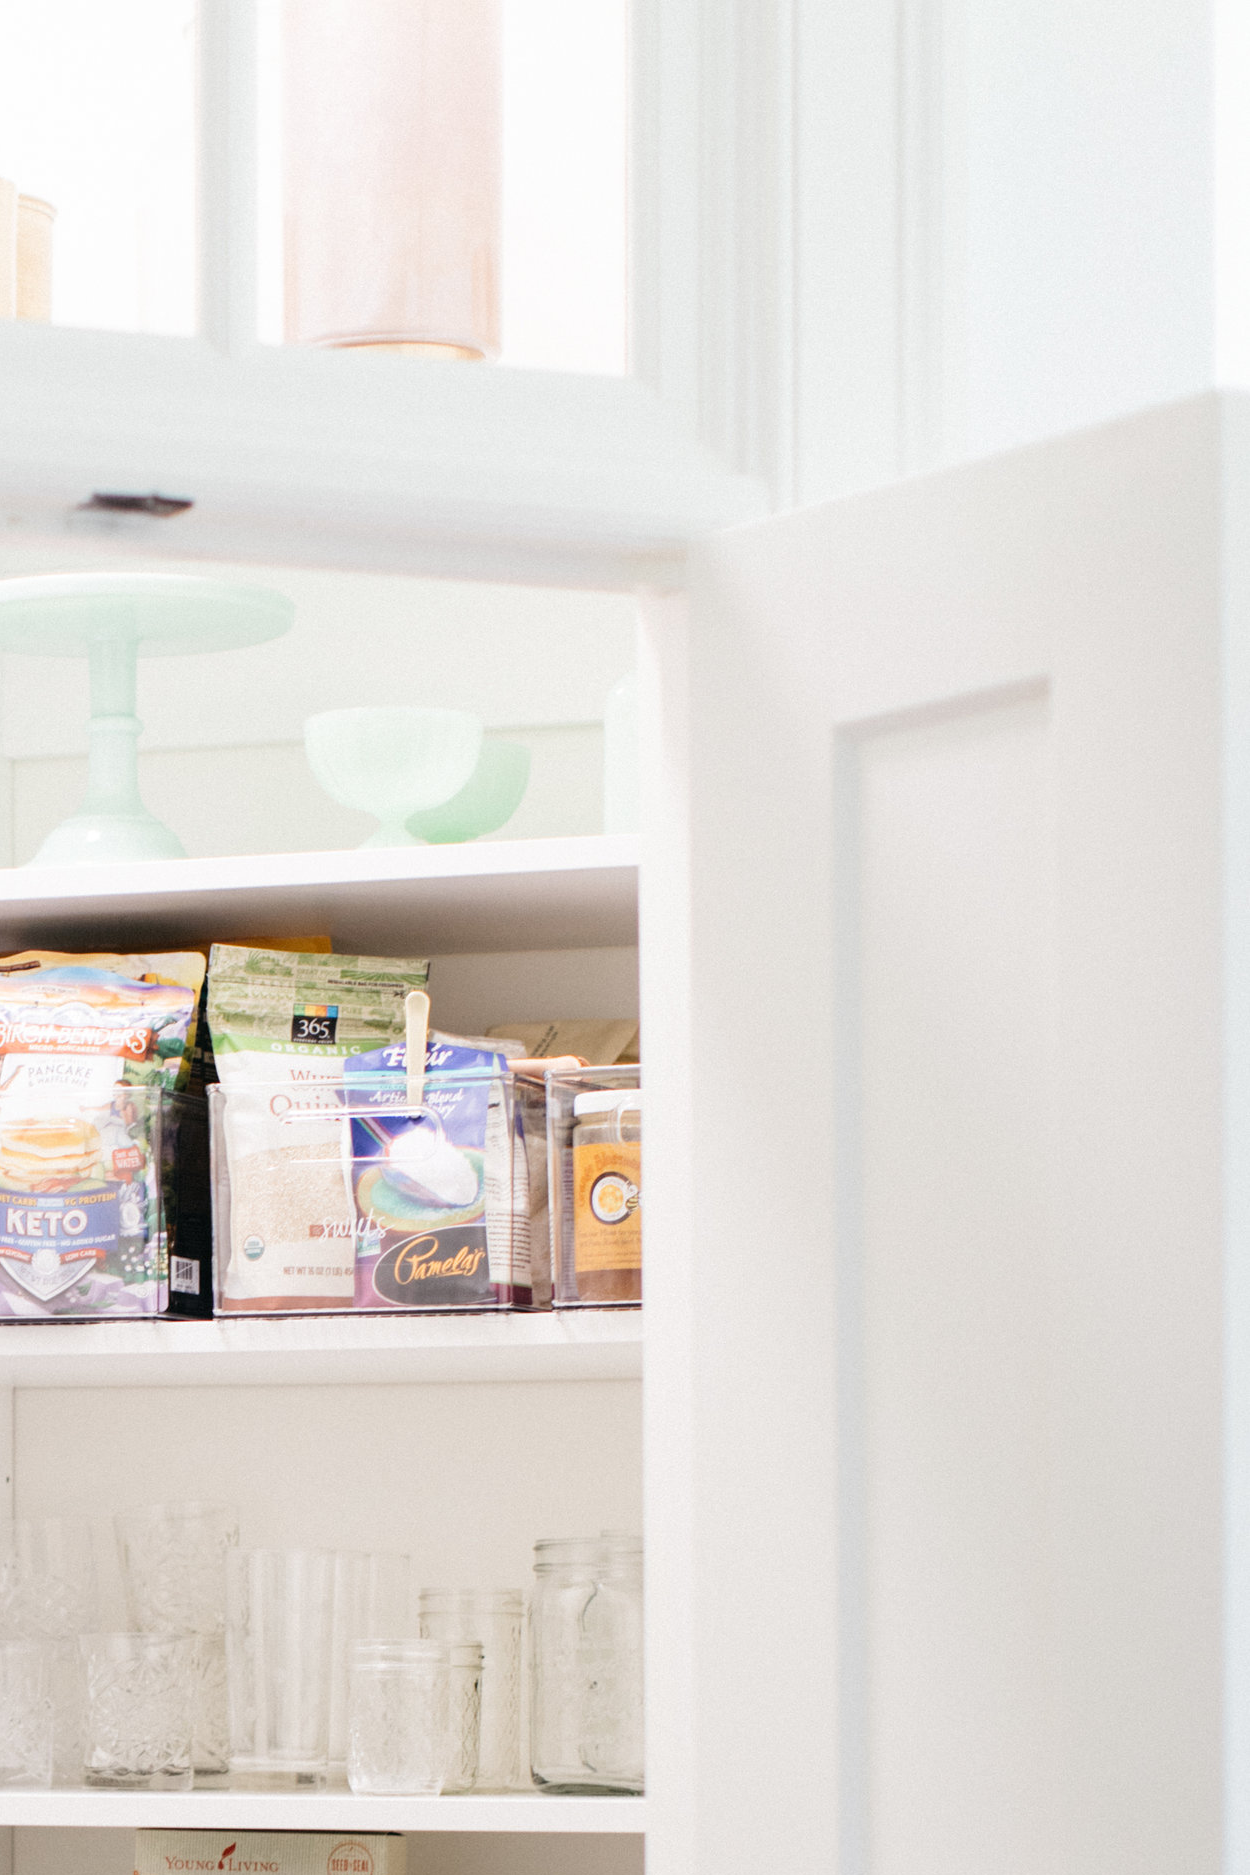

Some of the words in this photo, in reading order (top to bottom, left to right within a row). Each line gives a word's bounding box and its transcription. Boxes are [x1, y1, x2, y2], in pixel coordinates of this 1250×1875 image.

[296, 1018, 332, 1039] 365
[58, 1024, 147, 1055] BENDERS
[270, 1042, 362, 1057] ORGANIC
[28, 1064, 94, 1079] PANCAKE
[116, 1157, 142, 1170] WATER
[78, 1192, 117, 1205] PROTEIN
[6, 1207, 89, 1237] KETO
[393, 1234, 486, 1286] Pamela's
[165, 1855, 215, 1872] YOUNG
[227, 1857, 280, 1873] LIVING
[331, 1858, 348, 1873] SEED
[352, 1859, 369, 1873] SEAL
